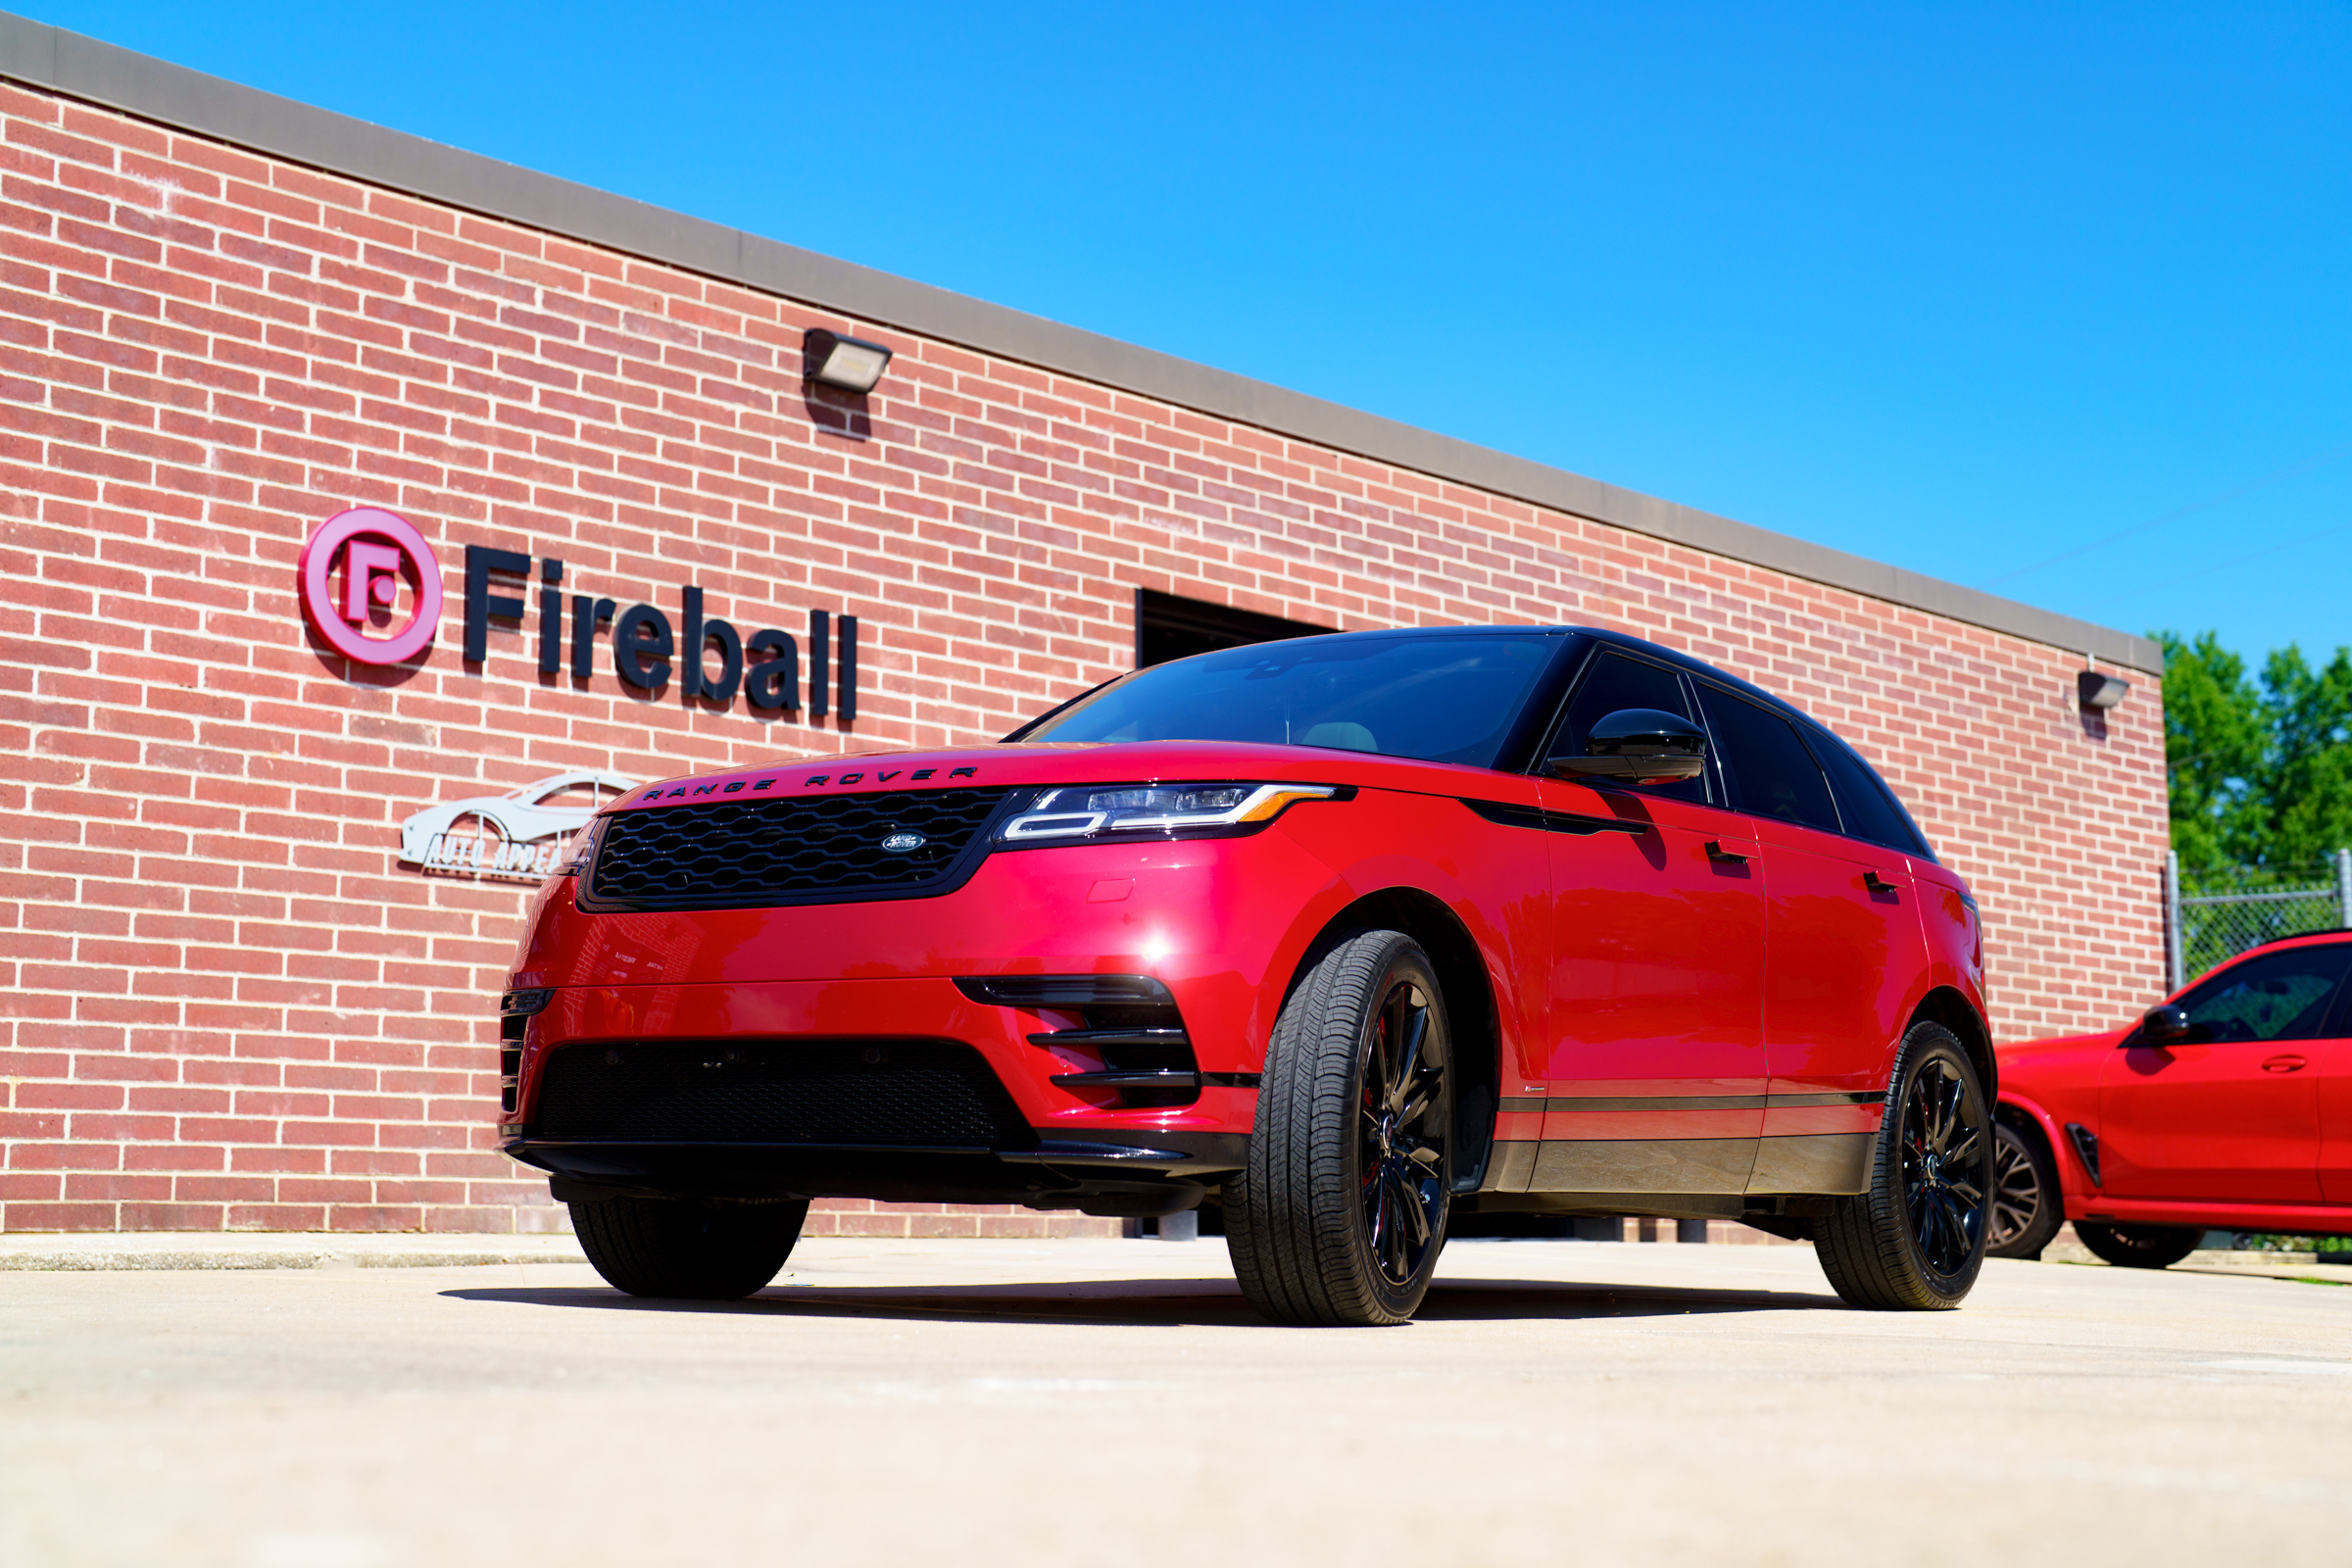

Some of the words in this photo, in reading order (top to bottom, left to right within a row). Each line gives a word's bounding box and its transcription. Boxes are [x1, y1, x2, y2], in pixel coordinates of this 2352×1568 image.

[465, 544, 858, 720] Fireball
[643, 778, 777, 801] RANGE
[804, 766, 978, 787] ROVER
[430, 833, 486, 867] AUTO
